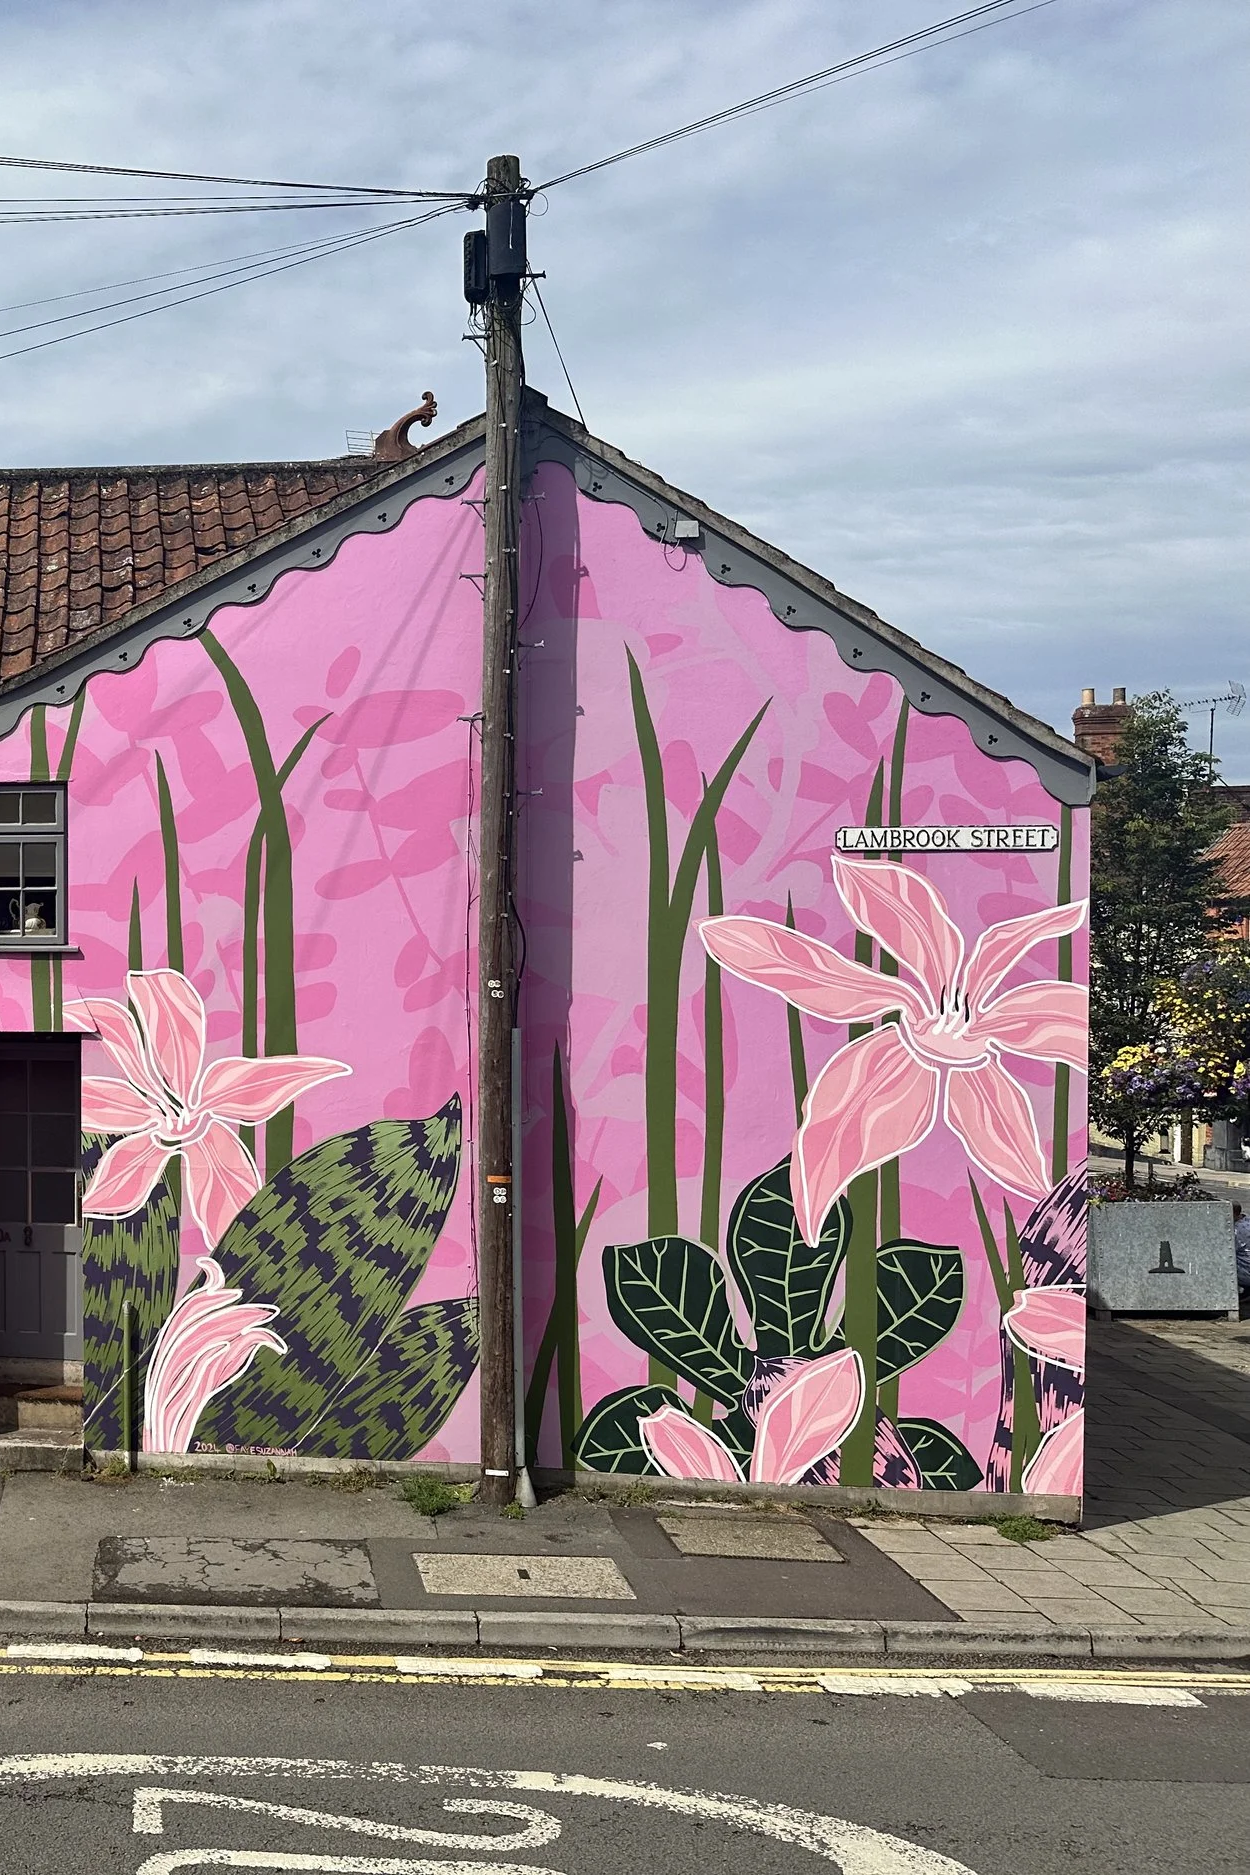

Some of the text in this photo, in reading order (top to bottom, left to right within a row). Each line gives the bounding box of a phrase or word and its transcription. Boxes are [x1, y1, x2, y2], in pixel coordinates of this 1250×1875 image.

[842, 828, 1050, 848] LAMBROOK STREET
[194, 1441, 221, 1453] 2024
